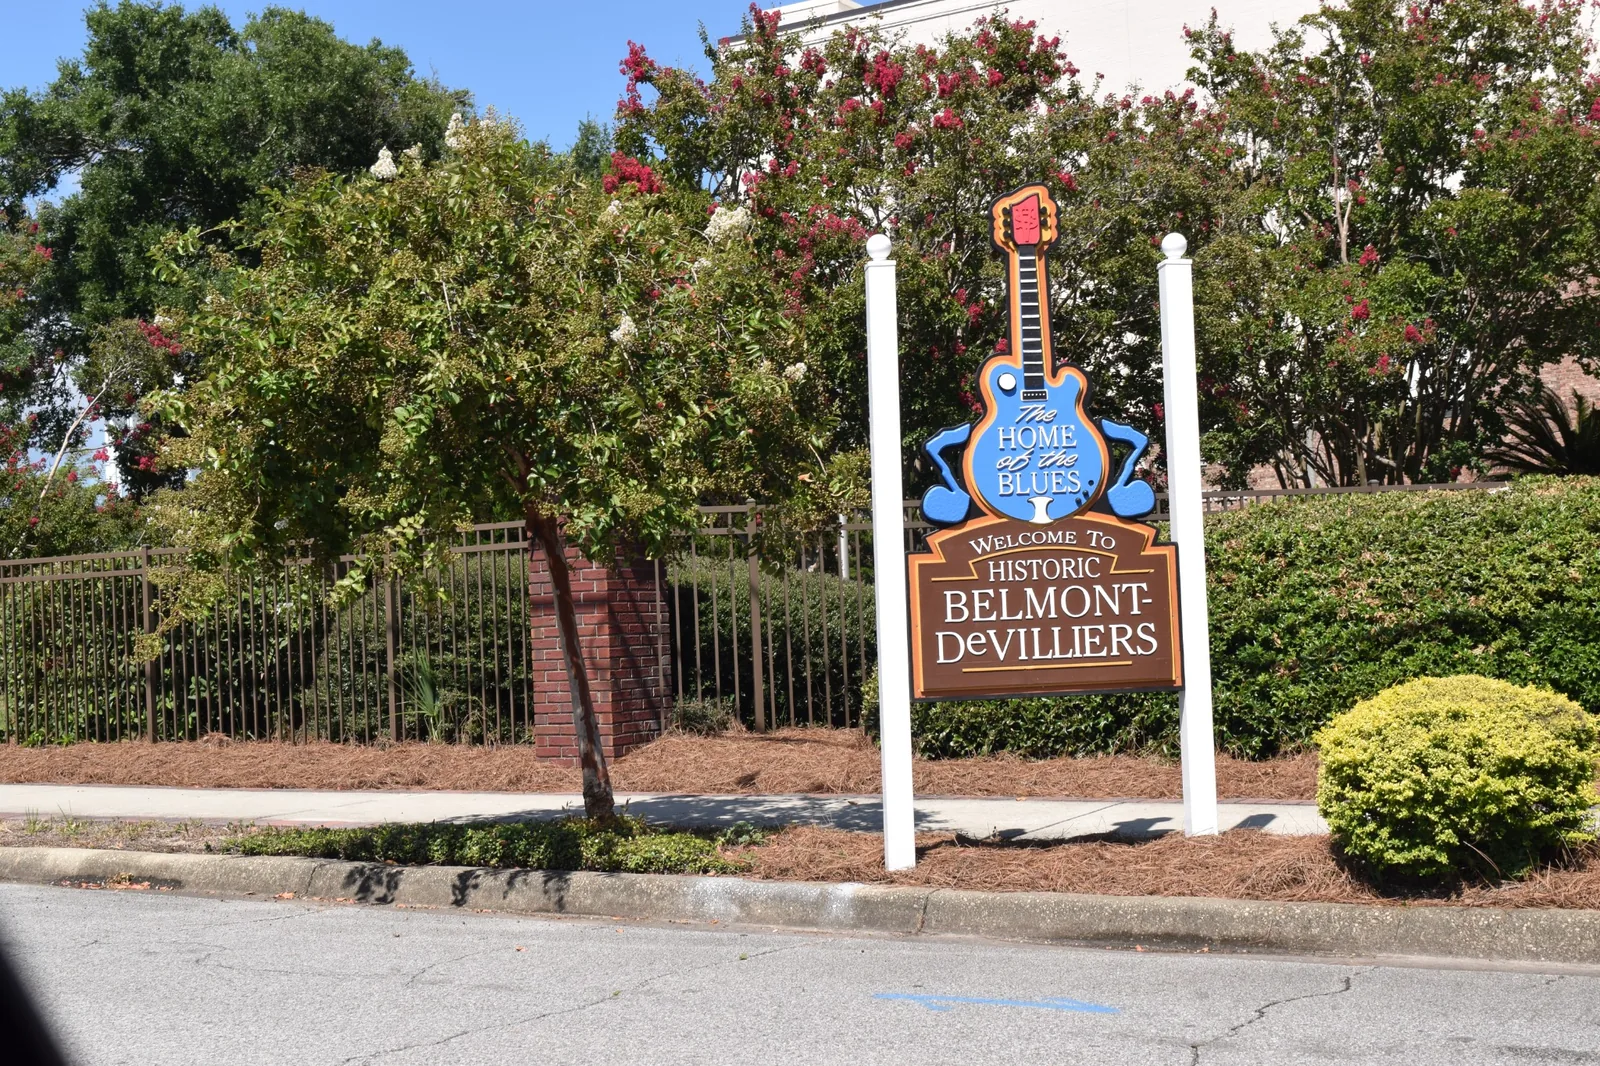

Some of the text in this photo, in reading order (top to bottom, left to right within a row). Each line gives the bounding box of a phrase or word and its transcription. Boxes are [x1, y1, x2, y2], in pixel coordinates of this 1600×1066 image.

[1015, 404, 1057, 423] The
[997, 425, 1077, 449] HOME
[996, 449, 1079, 471] of the
[997, 470, 1081, 496] BLUES
[969, 530, 1077, 555] WELCOME
[988, 557, 1101, 582] HISTORIC
[944, 582, 1153, 623] BELMONT-
[935, 622, 1158, 664] DeVILLIERS
